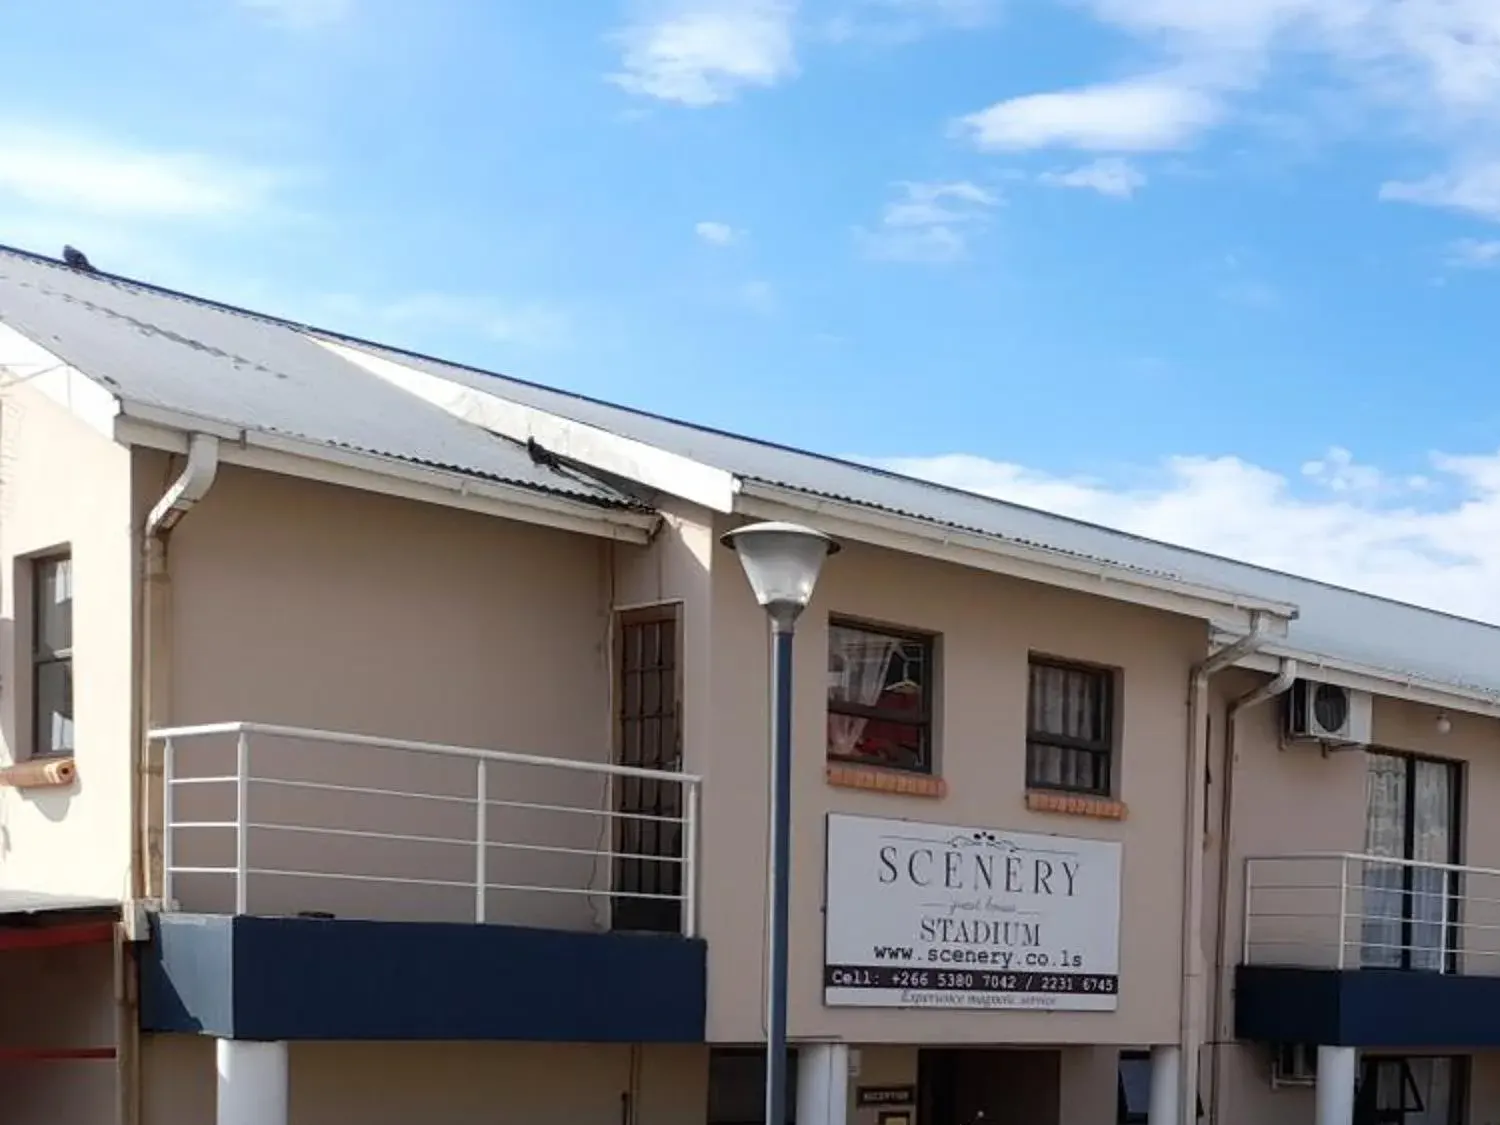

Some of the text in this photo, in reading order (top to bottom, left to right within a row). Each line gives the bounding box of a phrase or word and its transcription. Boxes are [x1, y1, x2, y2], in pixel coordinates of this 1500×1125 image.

[879, 846, 1079, 896] SCENERY
[920, 918, 1041, 946] STADIUM
[873, 945, 1083, 969] www.scenery.co.ls
[892, 971, 929, 986] +266
[1041, 977, 1073, 991] 2231
